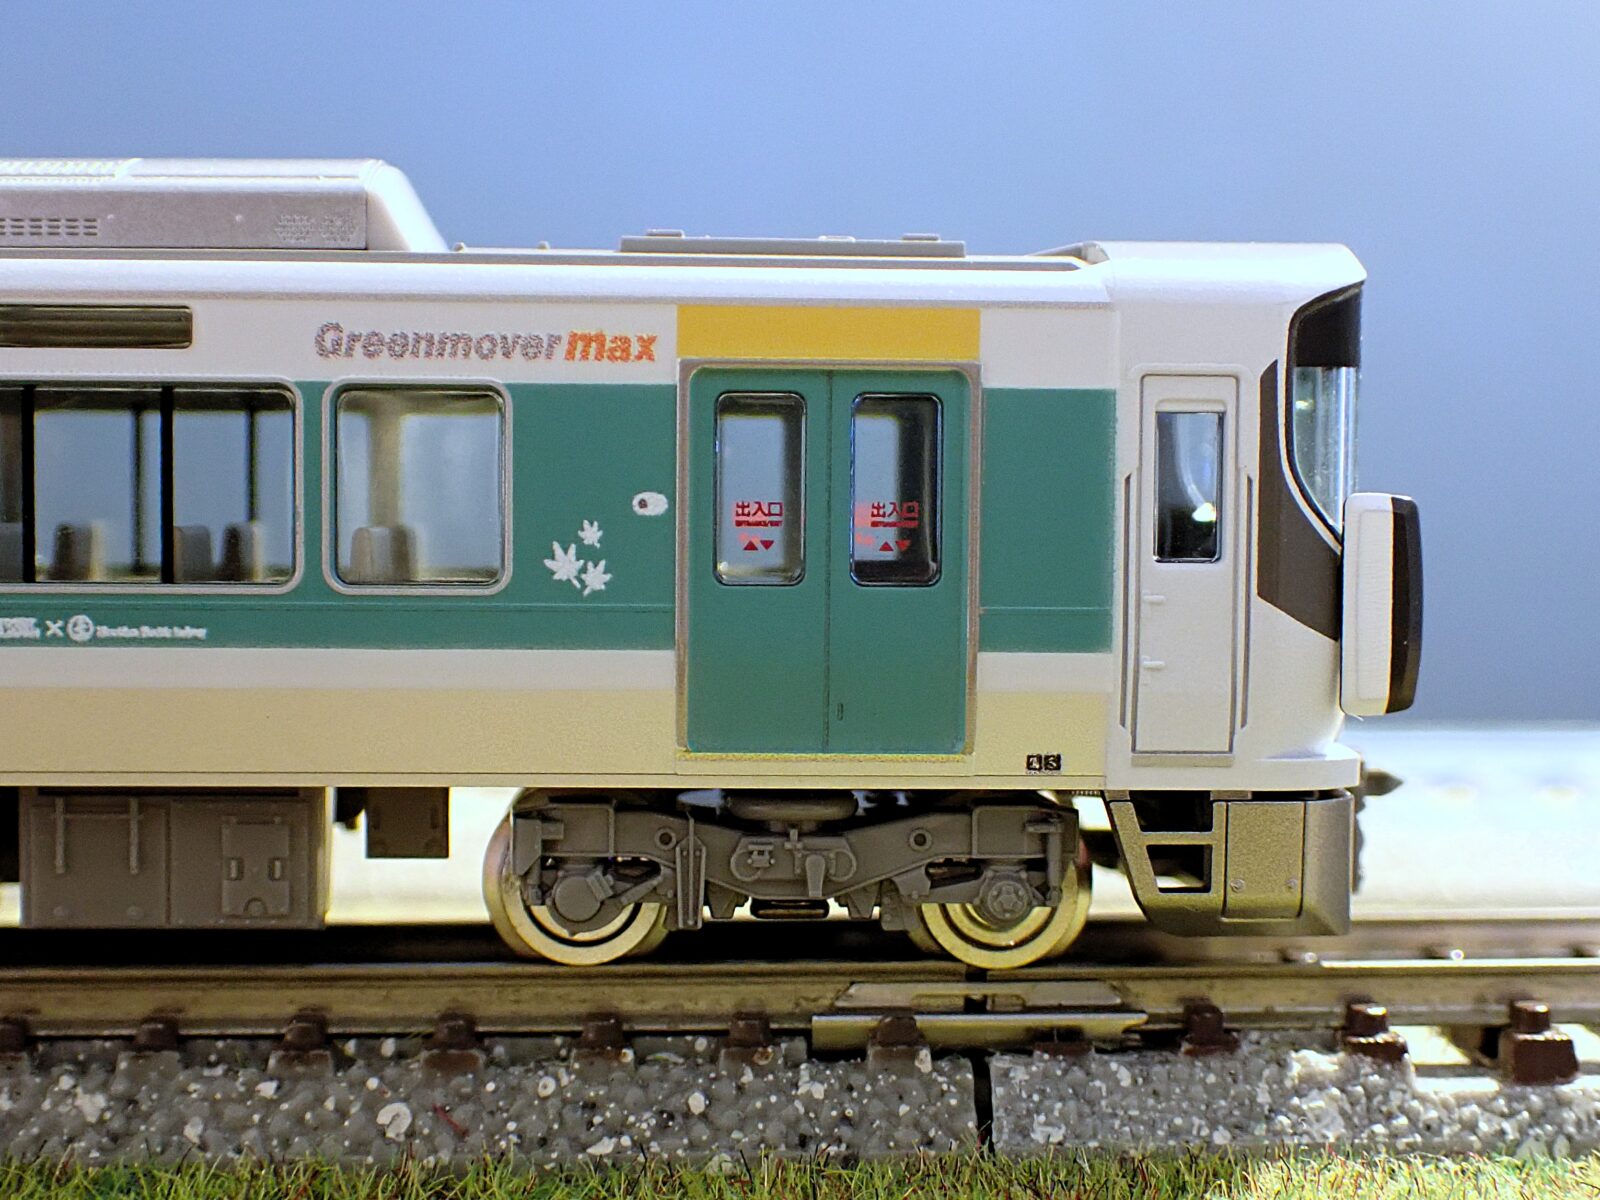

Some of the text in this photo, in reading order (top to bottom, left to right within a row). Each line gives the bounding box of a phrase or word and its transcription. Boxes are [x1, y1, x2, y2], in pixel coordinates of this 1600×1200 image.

[735, 501, 784, 518] 出入口
[869, 501, 921, 518] 出入口
